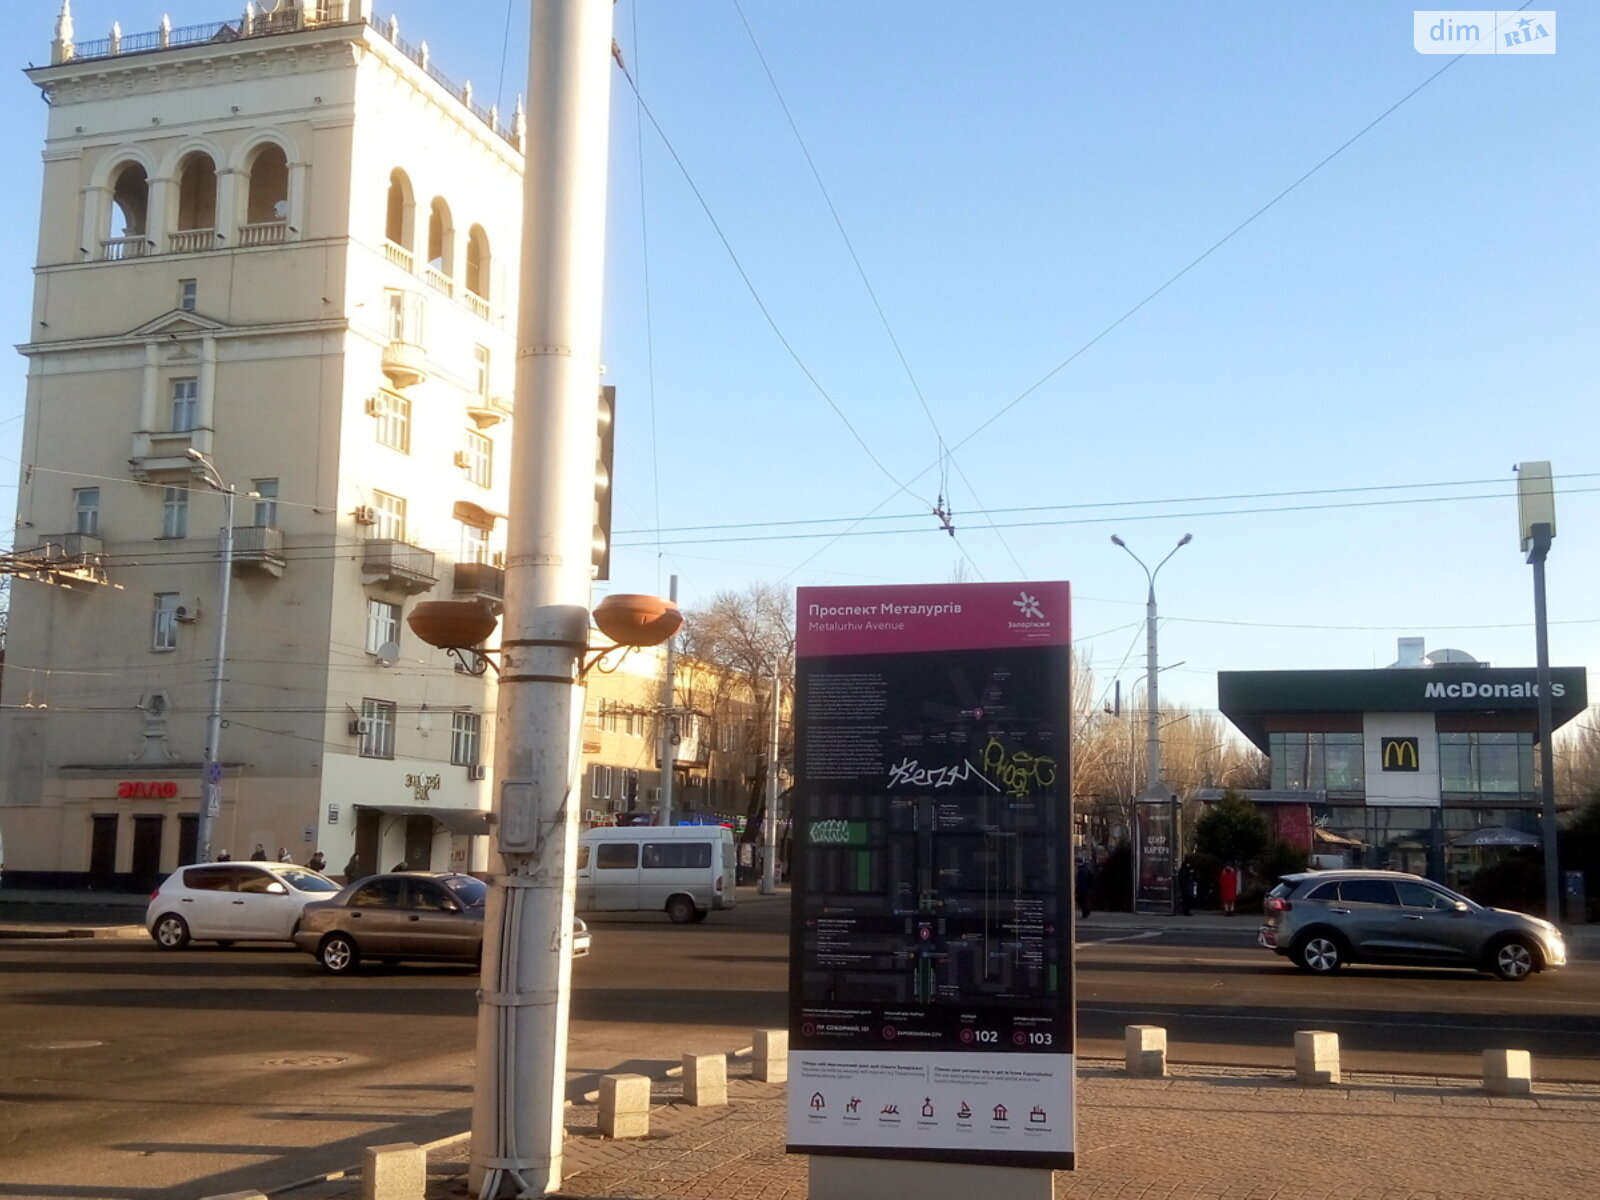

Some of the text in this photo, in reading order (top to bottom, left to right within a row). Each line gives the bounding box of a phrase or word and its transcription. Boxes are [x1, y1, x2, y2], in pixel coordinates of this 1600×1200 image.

[809, 602, 962, 619] Проспект Металургів
[808, 621, 905, 631] Metalurhiv Avenue
[1425, 681, 1566, 698] McDonals
[975, 1030, 998, 1043] 102
[1029, 1033, 1053, 1045] 103
